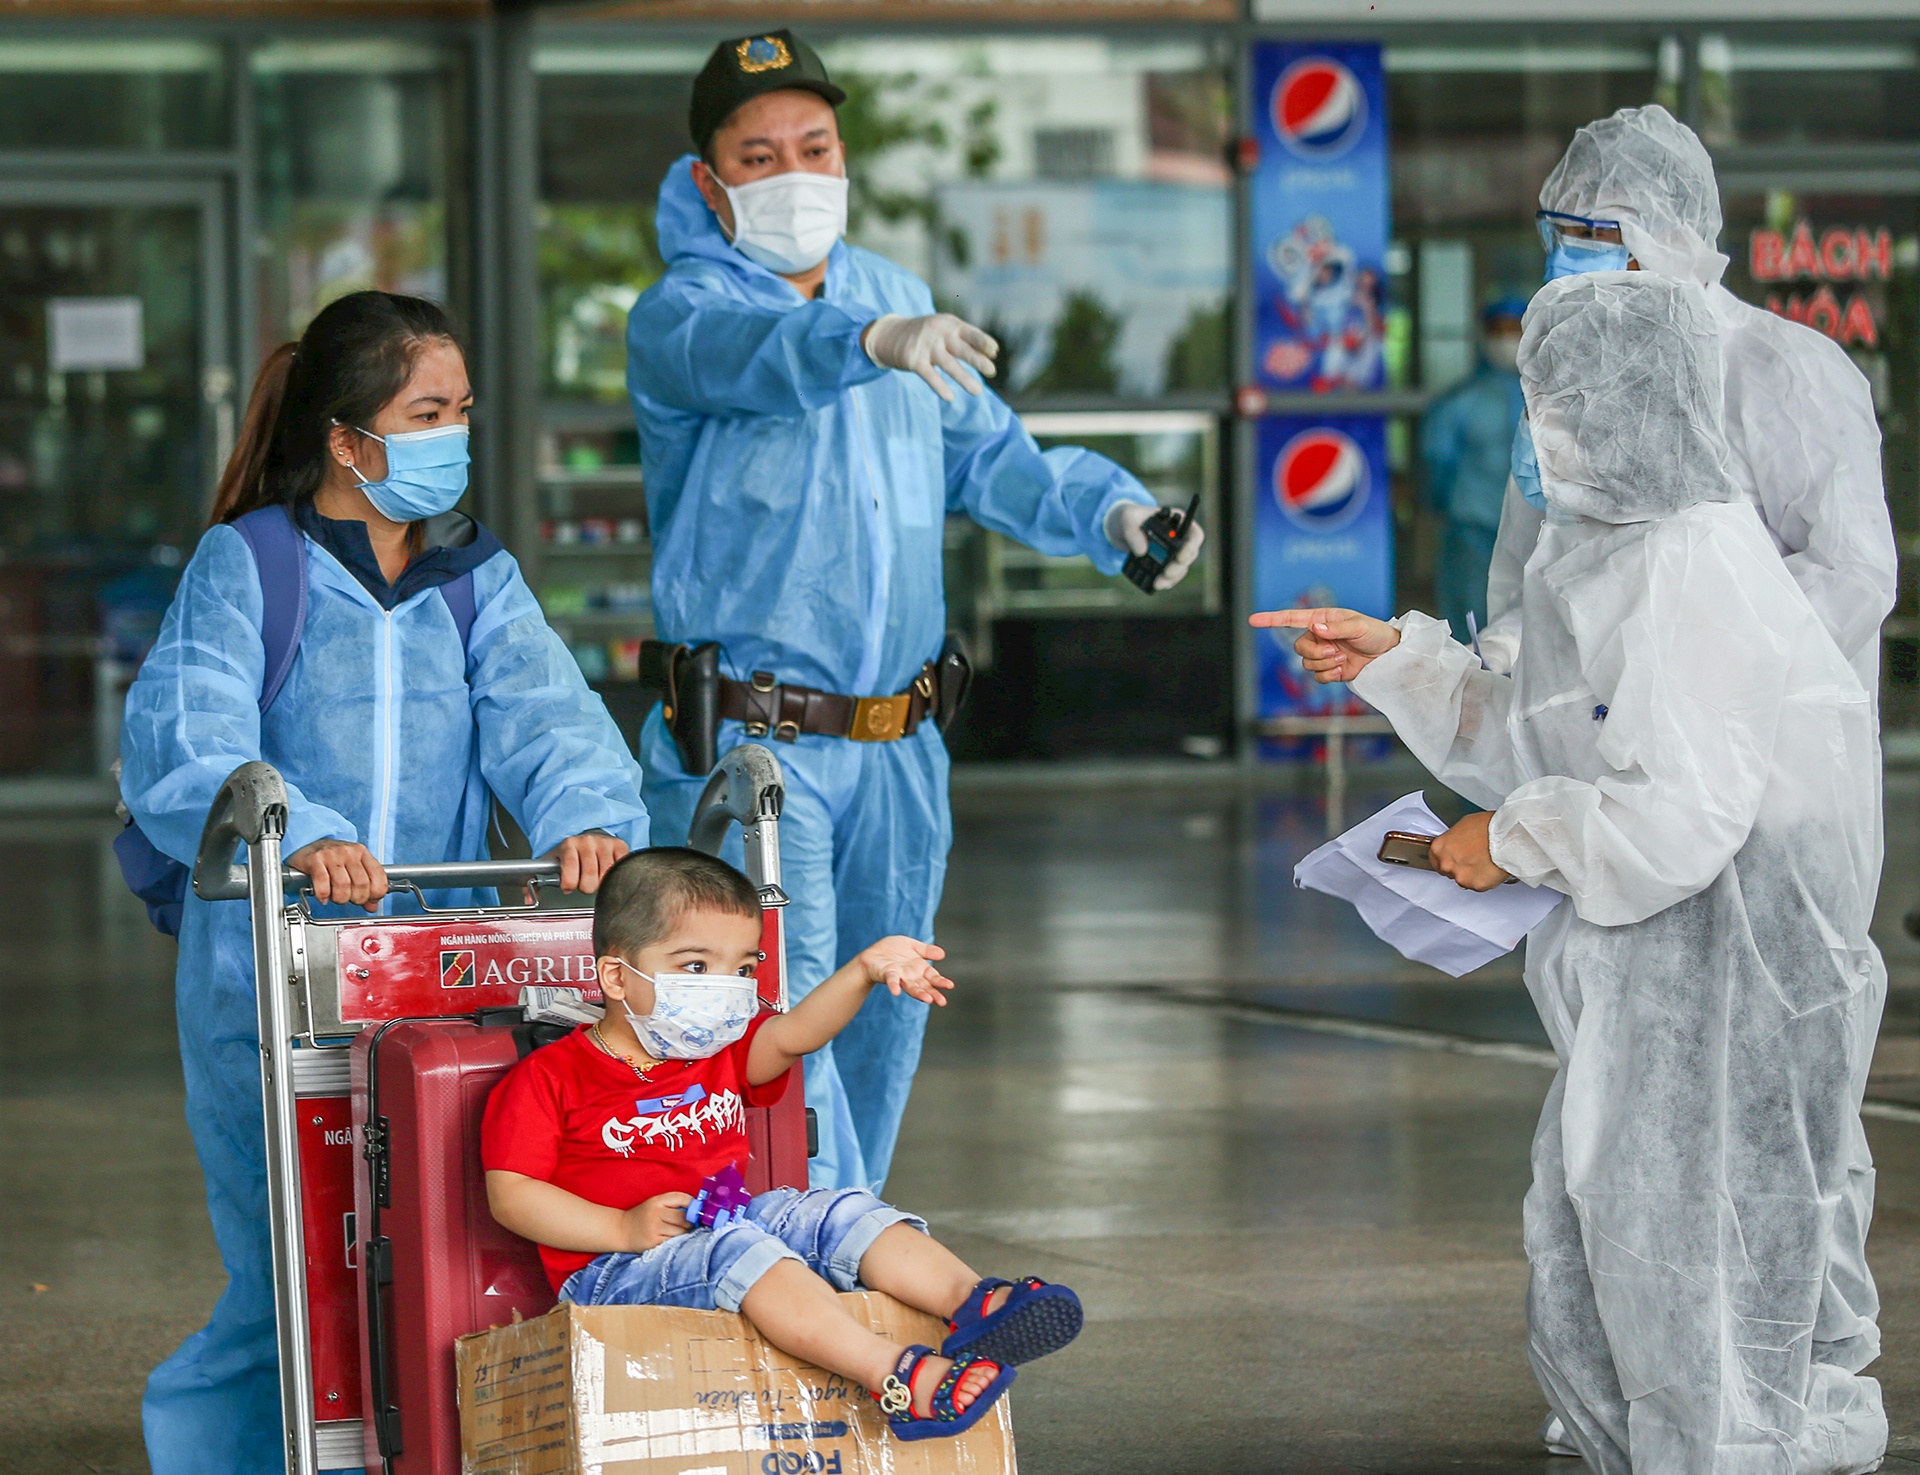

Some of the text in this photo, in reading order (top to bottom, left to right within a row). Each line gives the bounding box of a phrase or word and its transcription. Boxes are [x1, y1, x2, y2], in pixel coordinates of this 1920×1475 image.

[440, 934, 463, 945] NGÂN
[464, 933, 487, 945] HÀNG
[488, 932, 511, 944] NÔNG
[481, 954, 598, 986] AGRIB
[325, 1127, 353, 1145] NGÂ
[762, 1450, 842, 1475] FOOD
